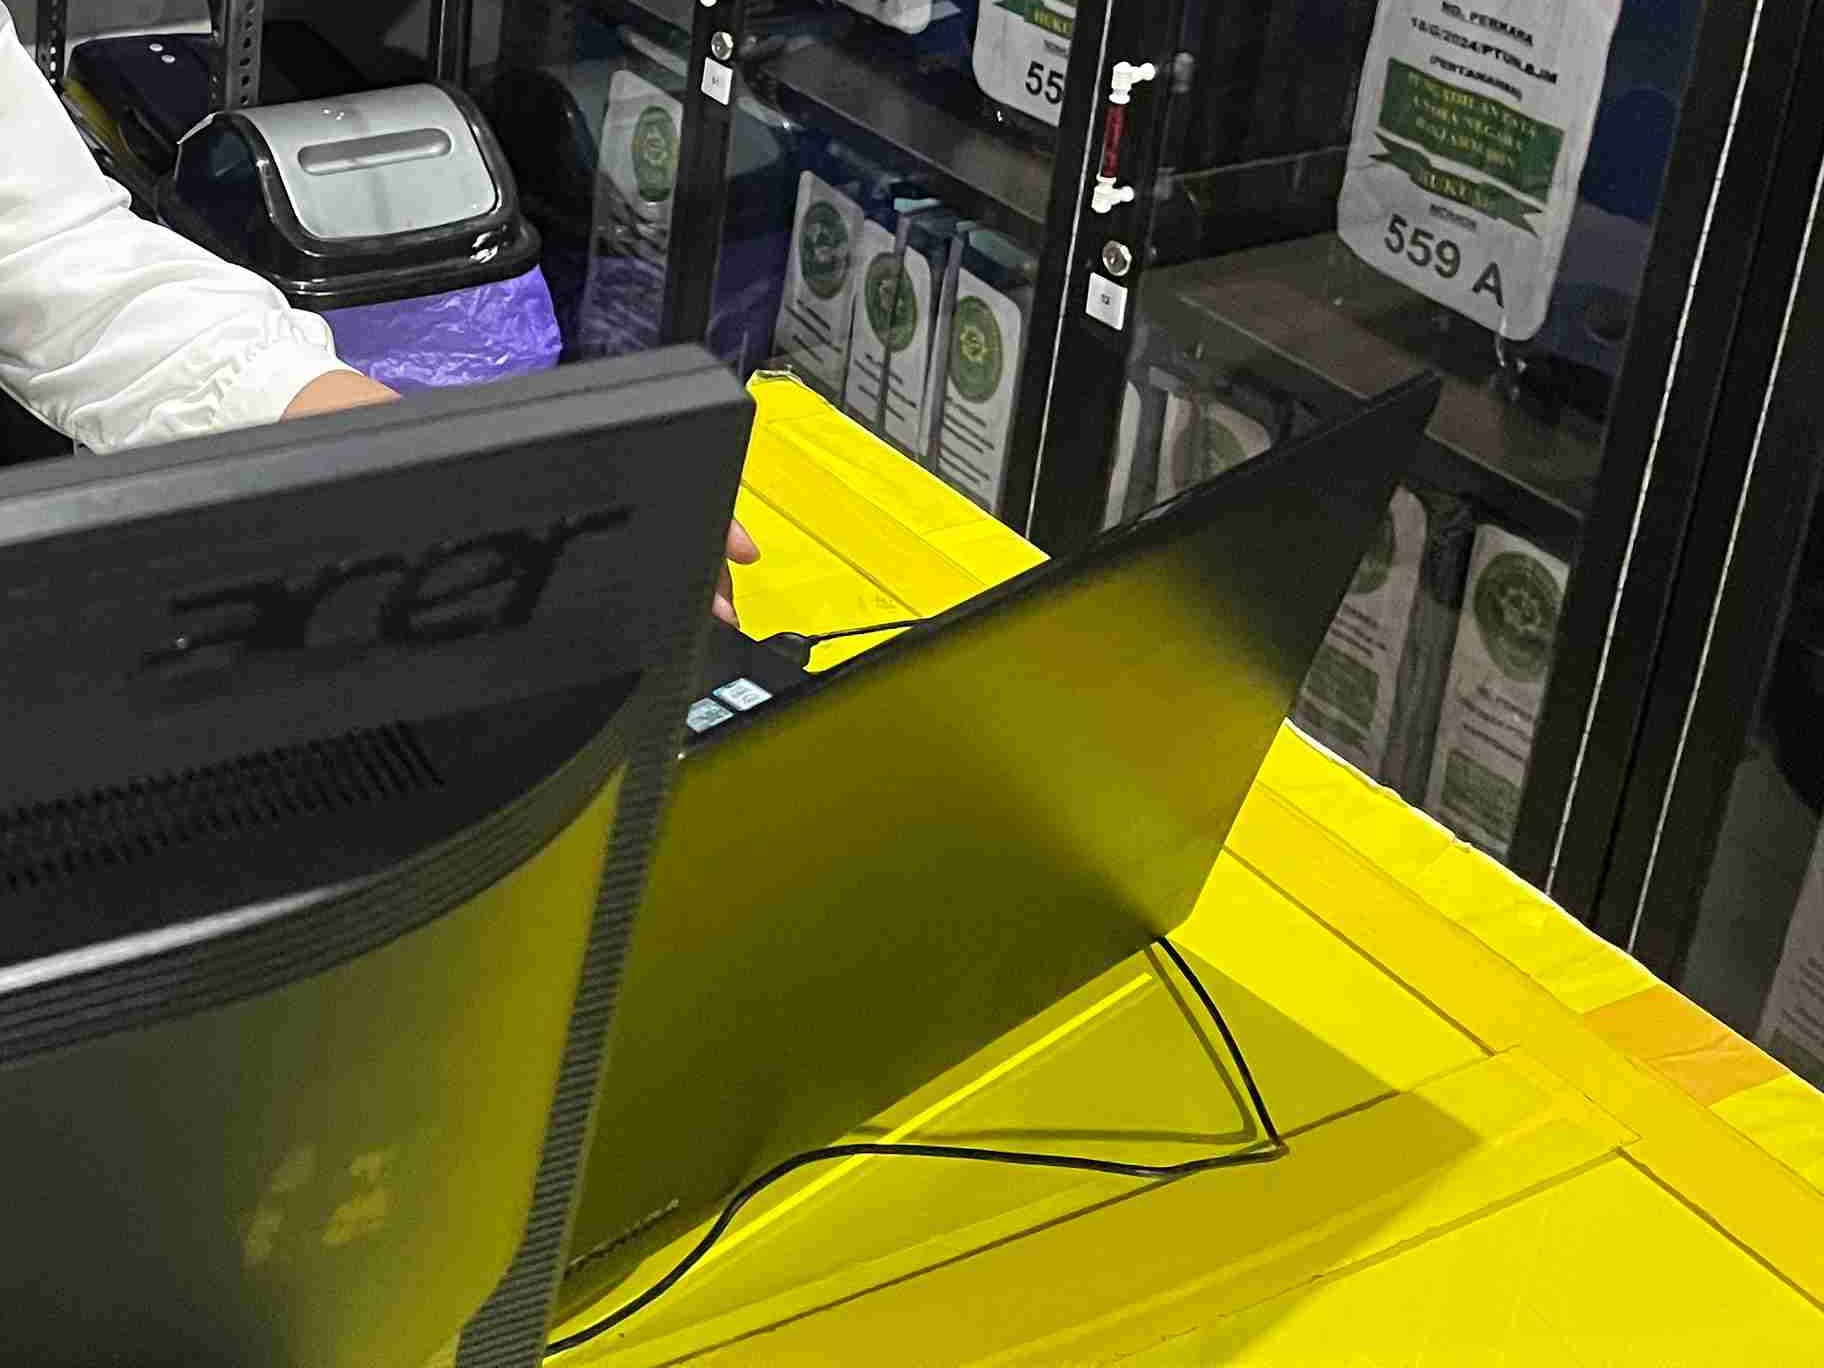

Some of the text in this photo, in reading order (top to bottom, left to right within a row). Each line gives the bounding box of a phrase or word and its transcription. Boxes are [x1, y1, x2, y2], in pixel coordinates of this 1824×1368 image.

[1469, 10, 1535, 48] PERKARA
[1384, 213, 1505, 310] 559 A
[138, 502, 638, 667] acer
